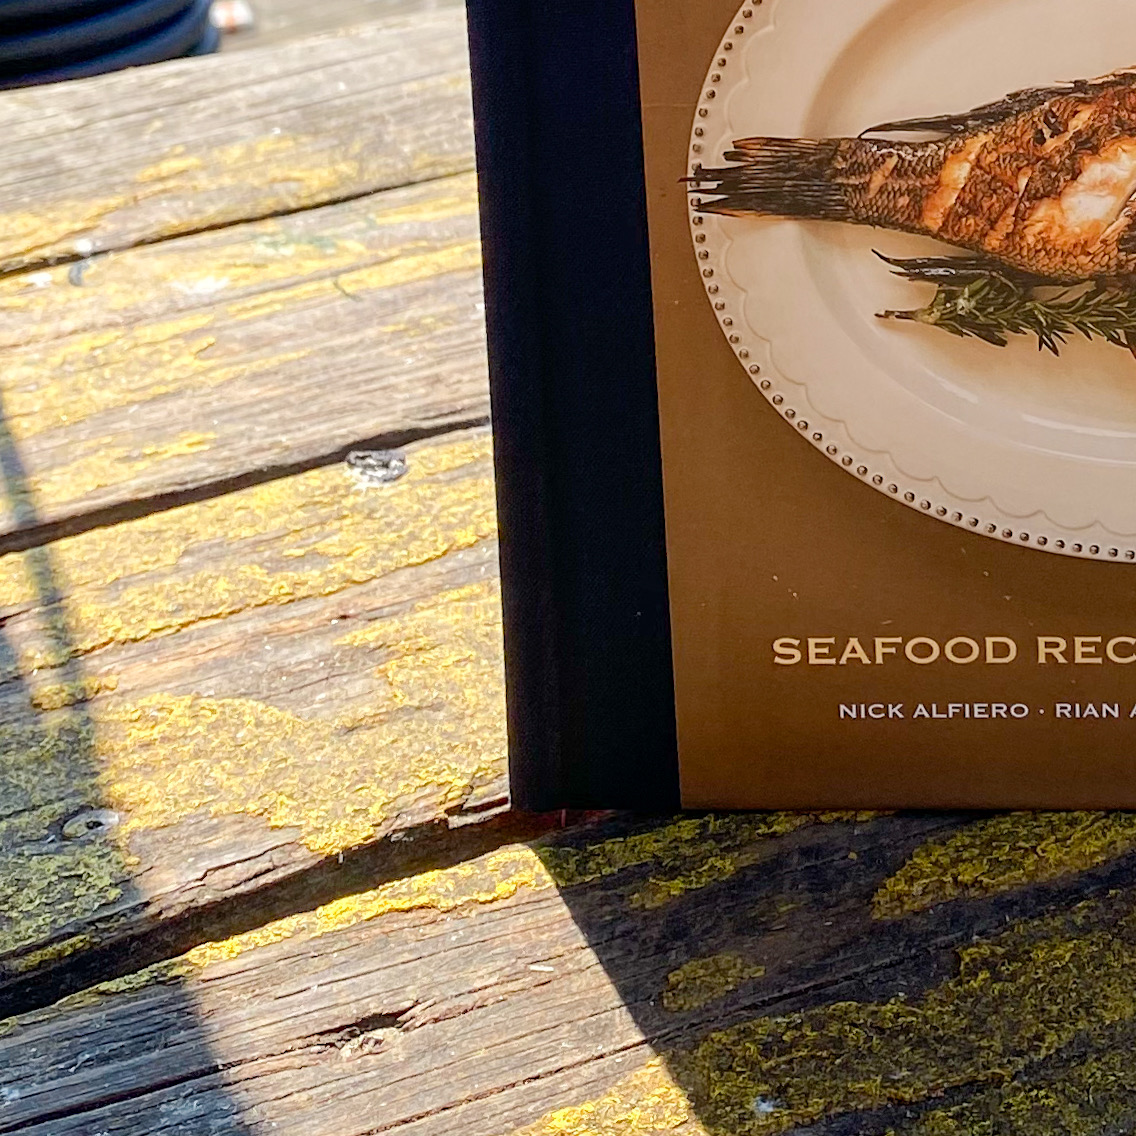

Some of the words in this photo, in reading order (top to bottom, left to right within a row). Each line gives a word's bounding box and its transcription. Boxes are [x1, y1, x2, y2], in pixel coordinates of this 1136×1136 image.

[772, 636, 1018, 666] SEAFOOD
[838, 703, 905, 720] NICK
[912, 703, 1030, 720] ALFIERO
[1055, 703, 1120, 720] RIAN
